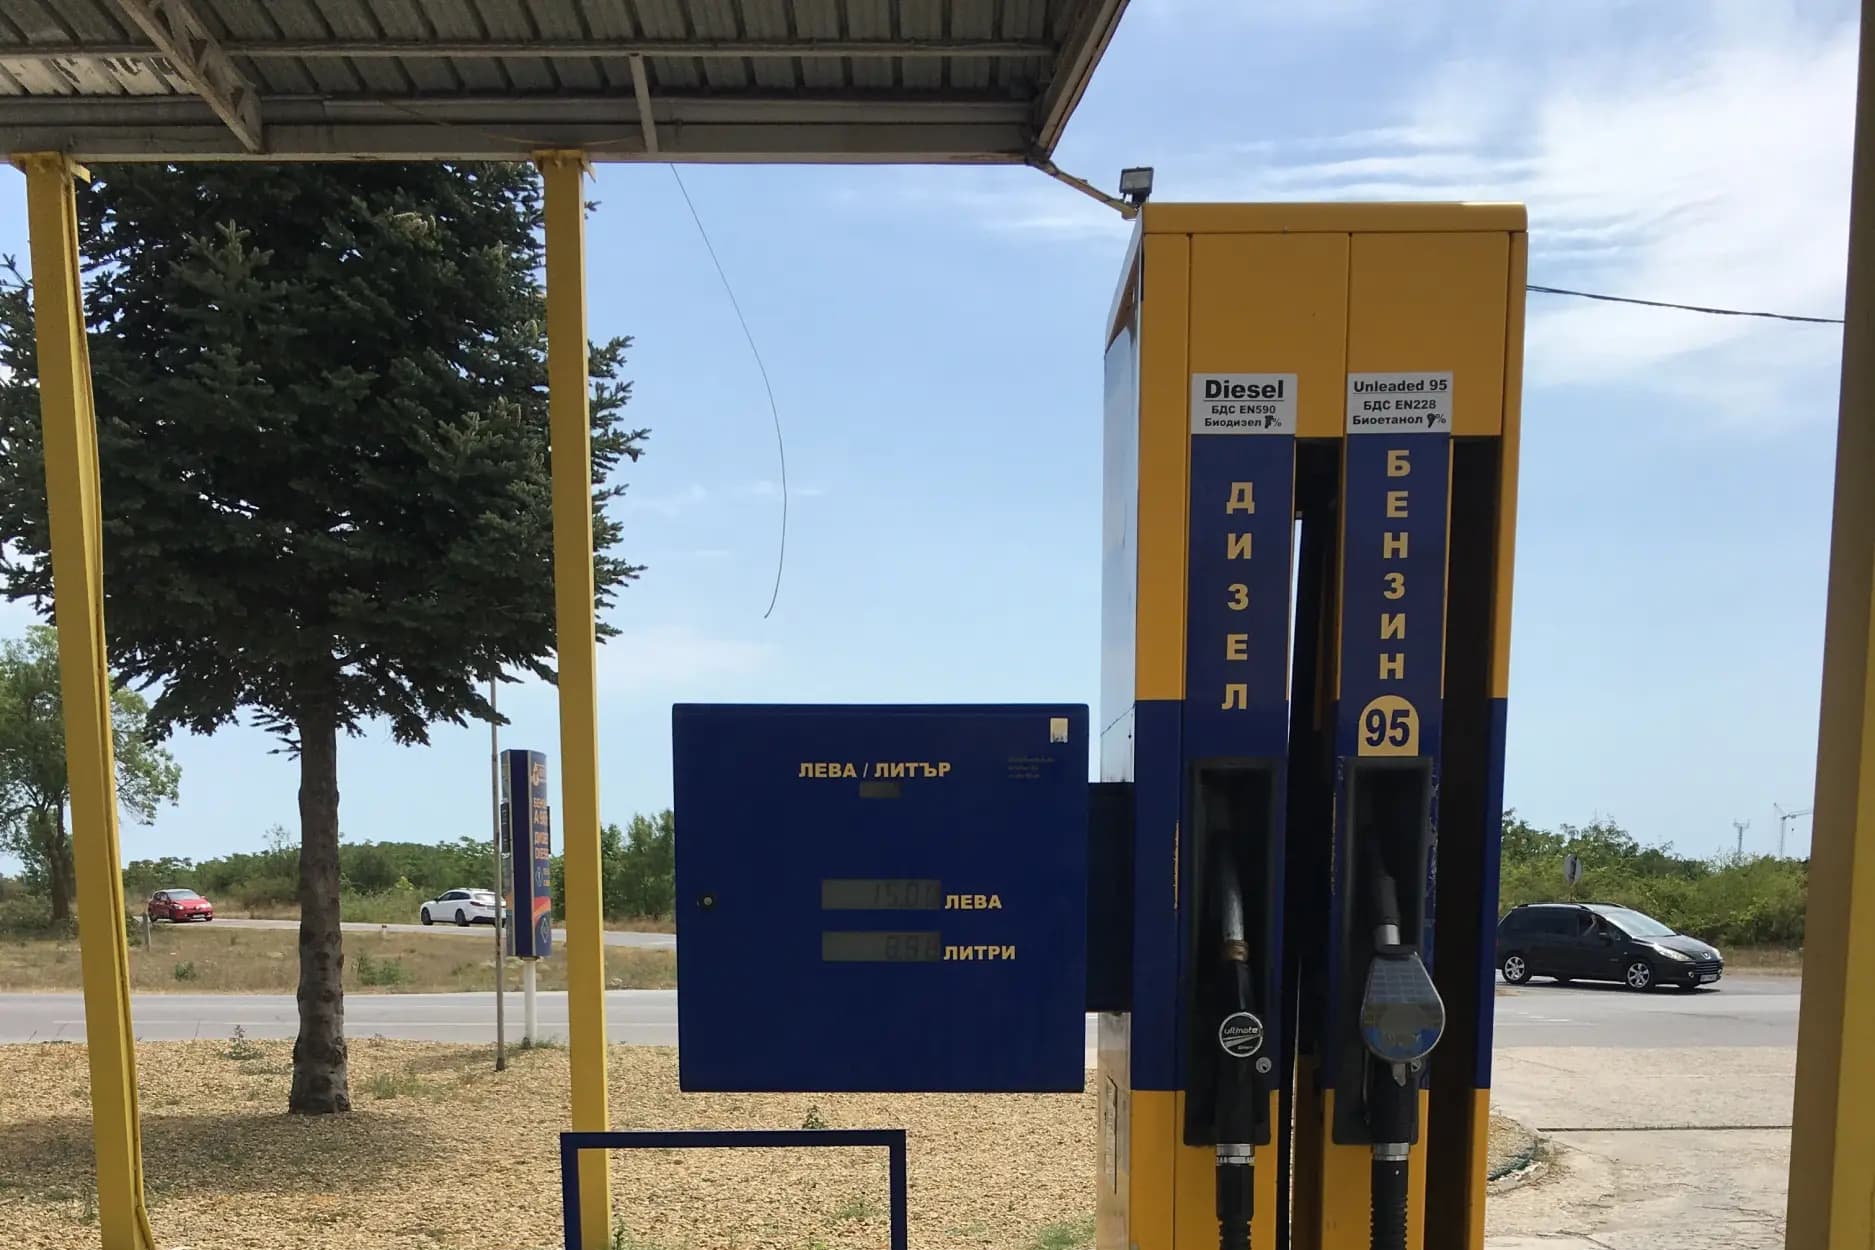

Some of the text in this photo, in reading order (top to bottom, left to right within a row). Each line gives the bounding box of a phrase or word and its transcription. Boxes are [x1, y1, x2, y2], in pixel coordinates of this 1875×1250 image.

[1205, 380, 1284, 399] Diesel
[1354, 379, 1448, 393] Unleaded 95
[1211, 405, 1276, 416] БДС EN590
[1363, 399, 1437, 412] БДС EN228
[1204, 418, 1262, 428] Биодизел
[1352, 415, 1423, 426] Биоетанол
[1379, 450, 1411, 680] БЕНЗИН
[1222, 482, 1255, 710] ДИЗЕЛ
[1365, 708, 1410, 747] 95
[799, 763, 857, 778] ЛЕВА
[875, 762, 951, 778] ЛИТЪР
[944, 894, 1002, 910] ЛЕВА
[944, 945, 1016, 960] ЛИТРИ
